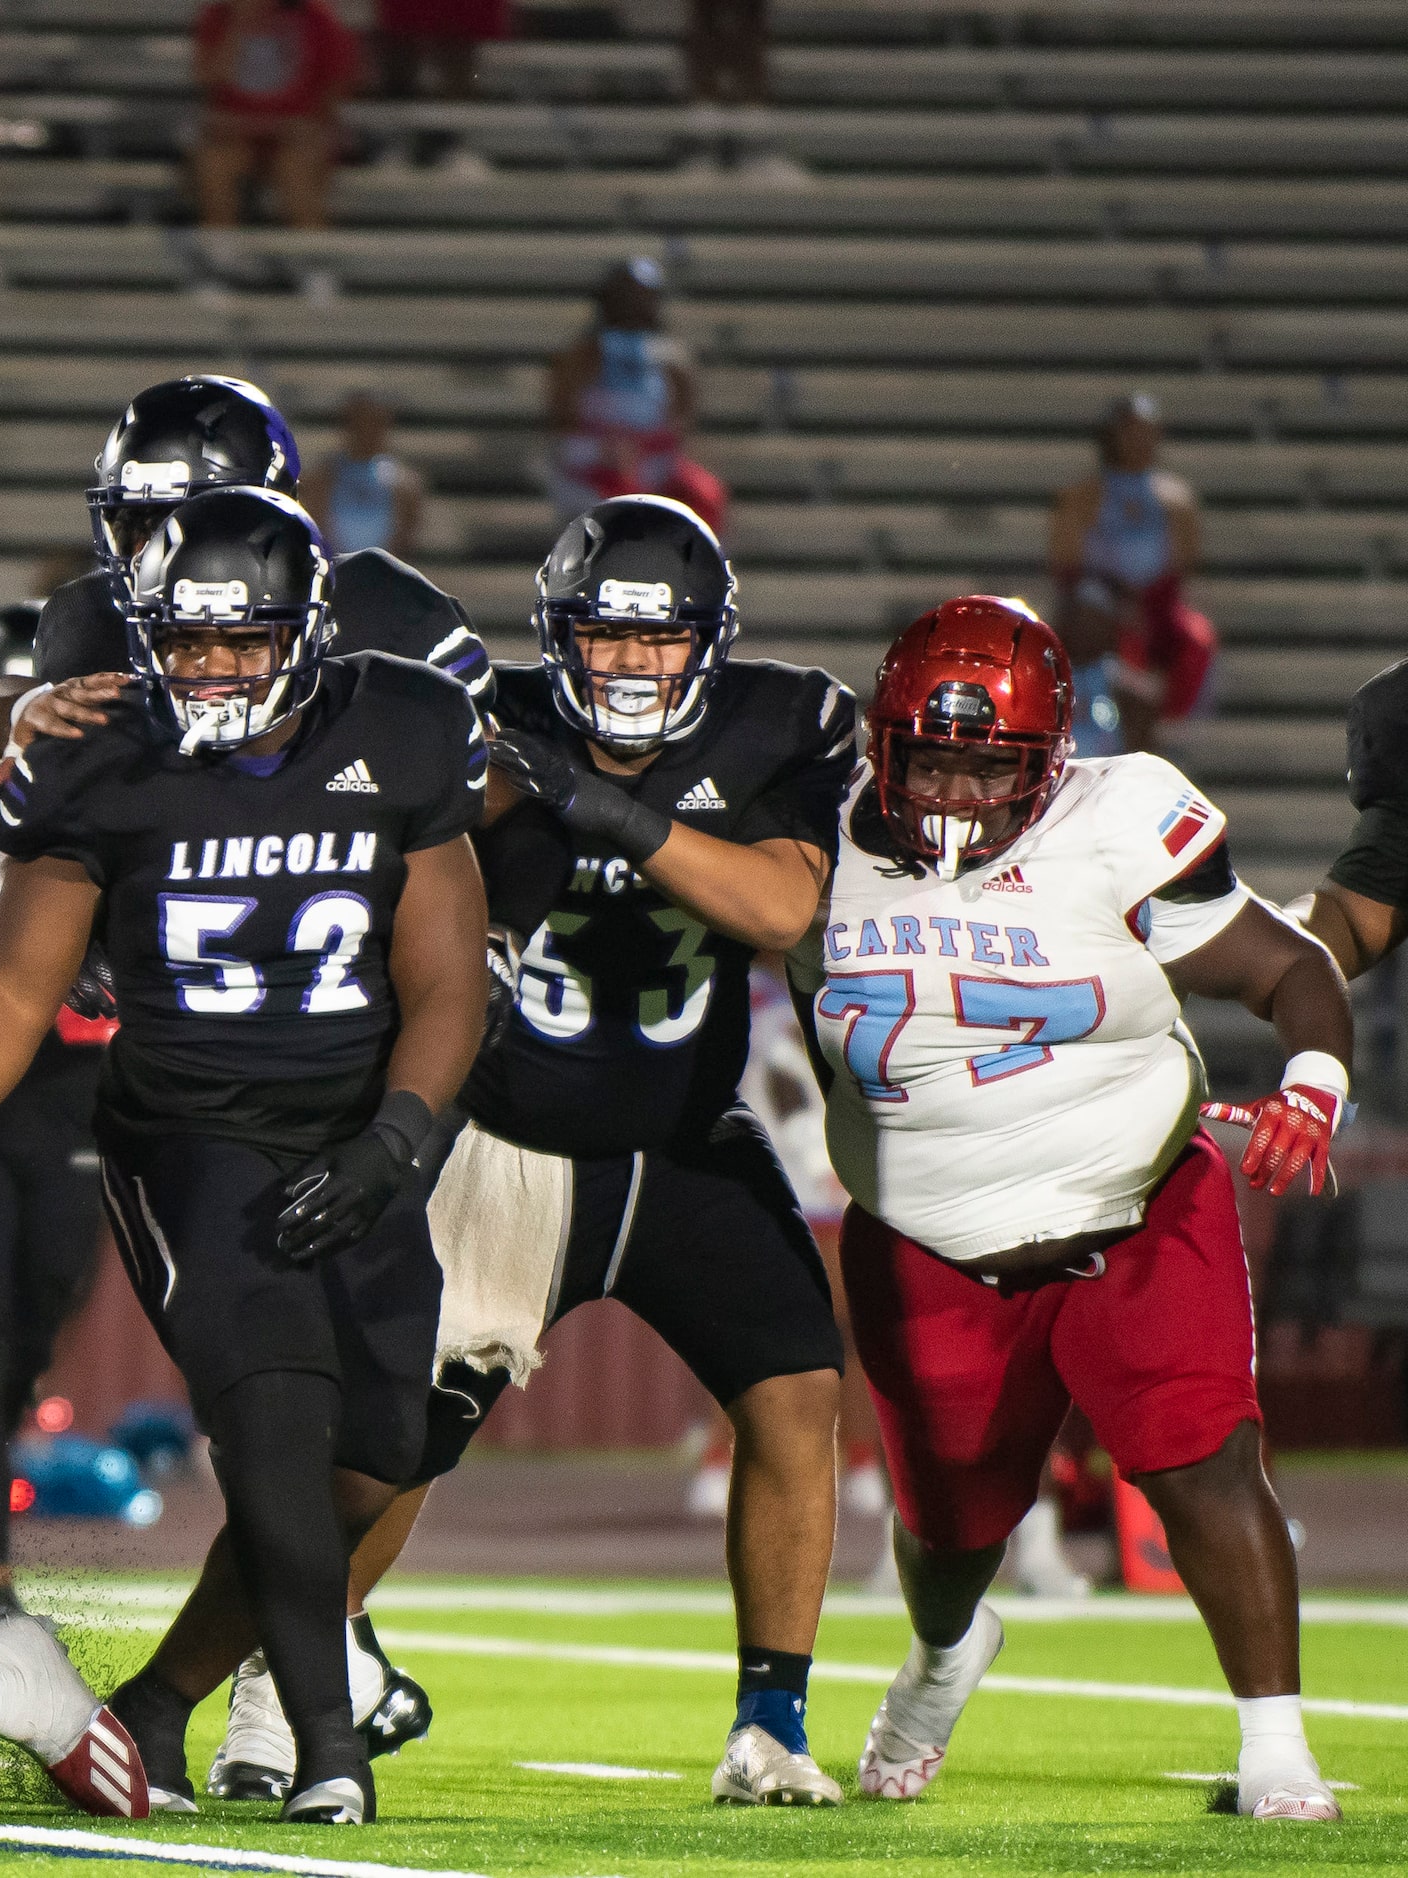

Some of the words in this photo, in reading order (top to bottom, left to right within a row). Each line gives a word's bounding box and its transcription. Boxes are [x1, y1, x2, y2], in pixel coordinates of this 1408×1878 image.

[326, 779, 379, 793] adidas
[676, 799, 727, 810] adidas
[165, 831, 378, 880] LINCOLN
[981, 880, 1033, 894] adidas
[157, 889, 373, 1014] 52
[825, 914, 1050, 967] CARTER
[513, 904, 717, 1048] 53
[818, 968, 1107, 1104] 77
